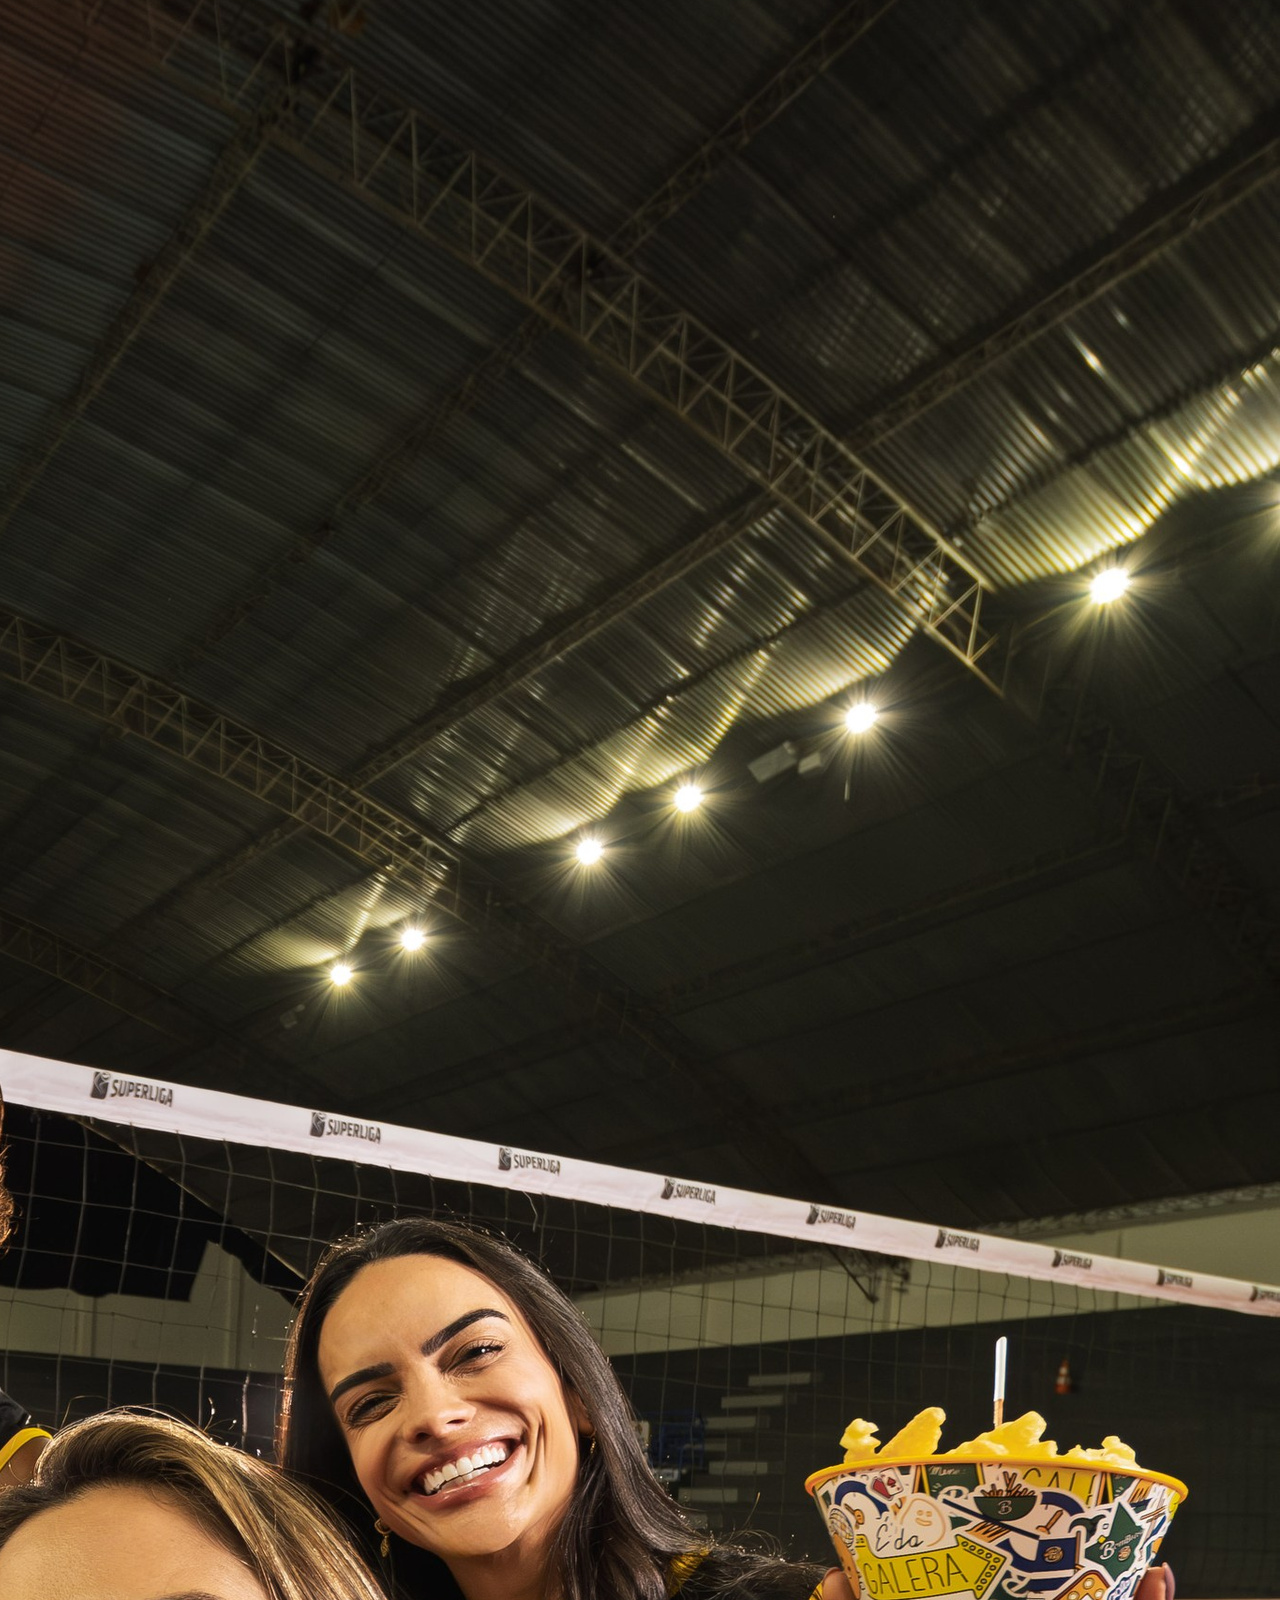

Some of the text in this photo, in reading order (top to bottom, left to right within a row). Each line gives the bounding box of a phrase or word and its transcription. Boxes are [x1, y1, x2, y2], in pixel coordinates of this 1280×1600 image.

[111, 1079, 173, 1107] SUPERLIGA
[327, 1118, 381, 1144] SUPERLIGA
[514, 1153, 561, 1176] SUPERLIGA
[674, 1184, 716, 1205] SUPERLIGA
[819, 1208, 857, 1230] SUPERLIGA
[863, 1553, 968, 1594] GALERA
